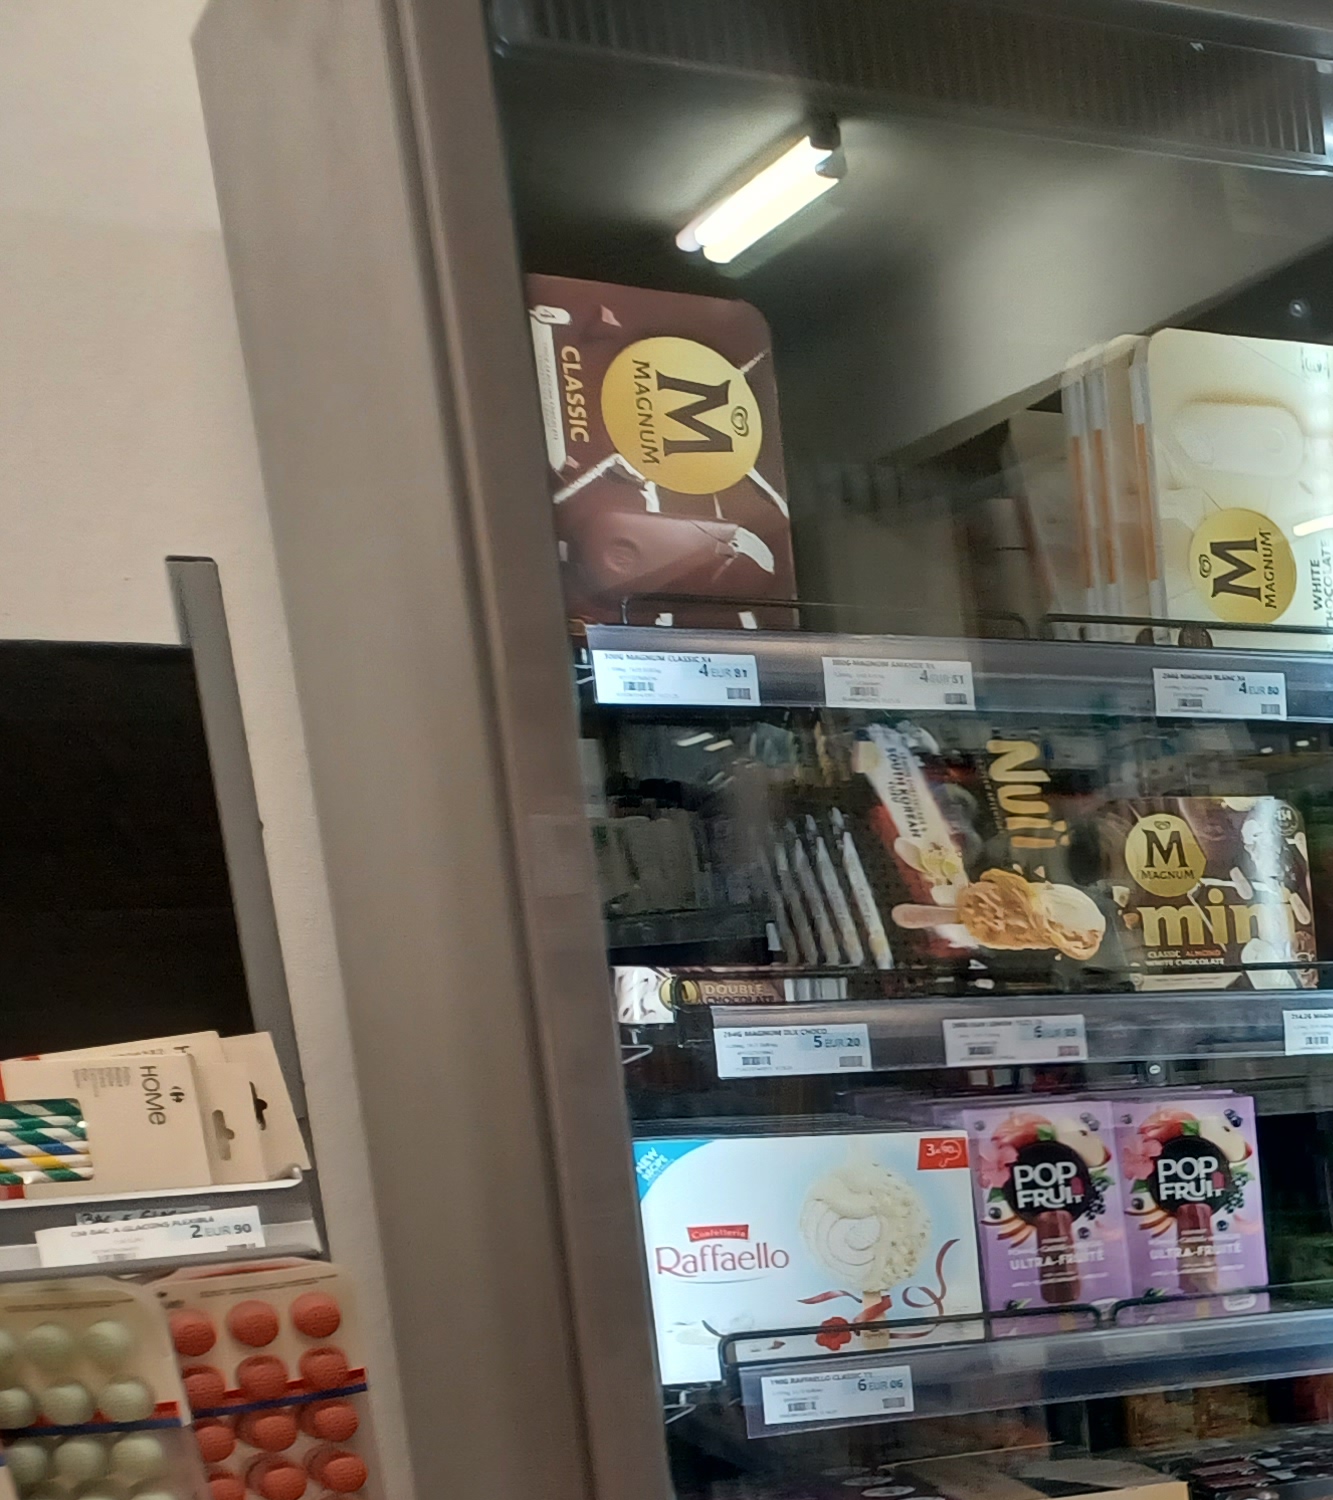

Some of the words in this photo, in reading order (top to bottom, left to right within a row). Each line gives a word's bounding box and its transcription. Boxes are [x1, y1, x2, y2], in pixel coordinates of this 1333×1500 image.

[561, 345, 590, 443] CLASSIC
[632, 358, 661, 465] MAGNUM
[656, 370, 734, 457] M
[1210, 537, 1262, 602] M
[1264, 528, 1279, 610] MAGNUM
[1310, 559, 1323, 612] WHITE
[699, 664, 708, 677] 4
[711, 669, 731, 678] EUR
[919, 670, 929, 683] 4
[1238, 682, 1247, 695] 4
[1248, 685, 1267, 695] EUR
[1142, 828, 1189, 868] M
[1140, 869, 1195, 880] MAGNUM
[704, 983, 765, 995] DOUBLE
[813, 1036, 823, 1049] 5
[824, 1039, 845, 1049] EUR
[635, 1147, 660, 1173] NEW
[1157, 1156, 1219, 1184] POP
[1013, 1161, 1077, 1191] POP
[190, 1224, 203, 1240] 2
[204, 1226, 232, 1238] EUR
[234, 1223, 252, 1235] 90
[655, 1242, 790, 1279] Raffaello
[857, 1377, 867, 1391] 6
[868, 1380, 888, 1391] EUR
